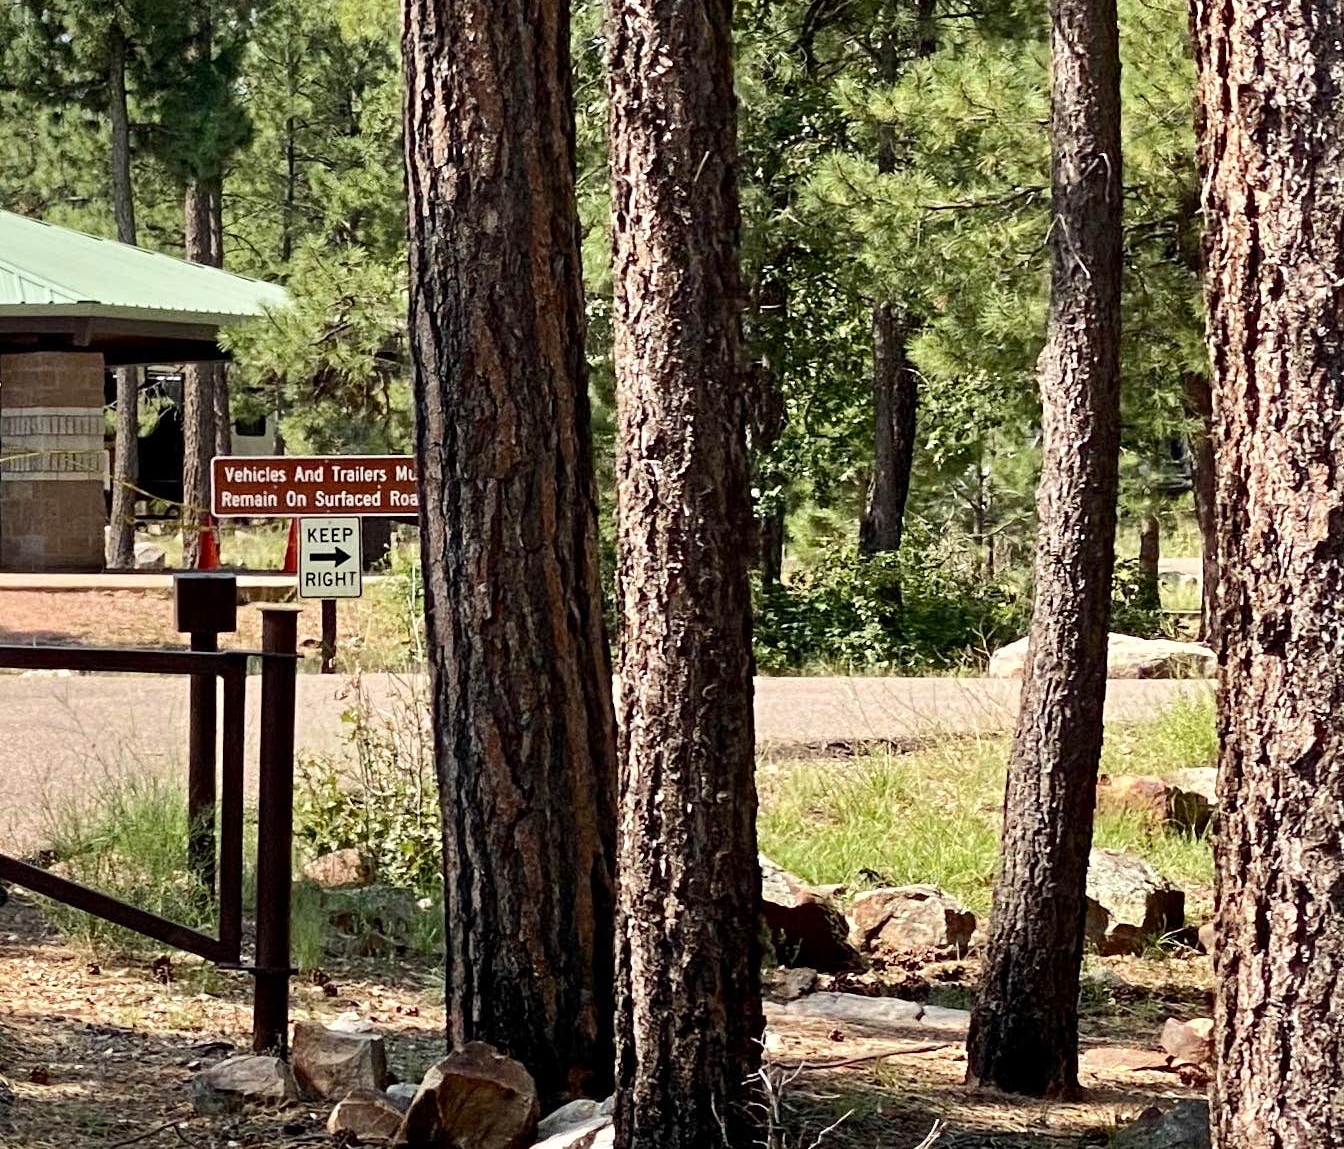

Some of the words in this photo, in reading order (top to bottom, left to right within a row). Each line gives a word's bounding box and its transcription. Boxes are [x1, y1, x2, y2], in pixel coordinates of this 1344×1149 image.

[225, 467, 286, 482] Vehicles
[295, 466, 323, 482] And
[332, 466, 386, 482] Trailers
[396, 466, 417, 481] Mu
[222, 492, 277, 507] Remain
[286, 491, 307, 507] On
[315, 491, 381, 507] Surfaced
[391, 491, 419, 506] Roa
[308, 528, 353, 543] KEEP
[306, 572, 356, 586] RIGHT
